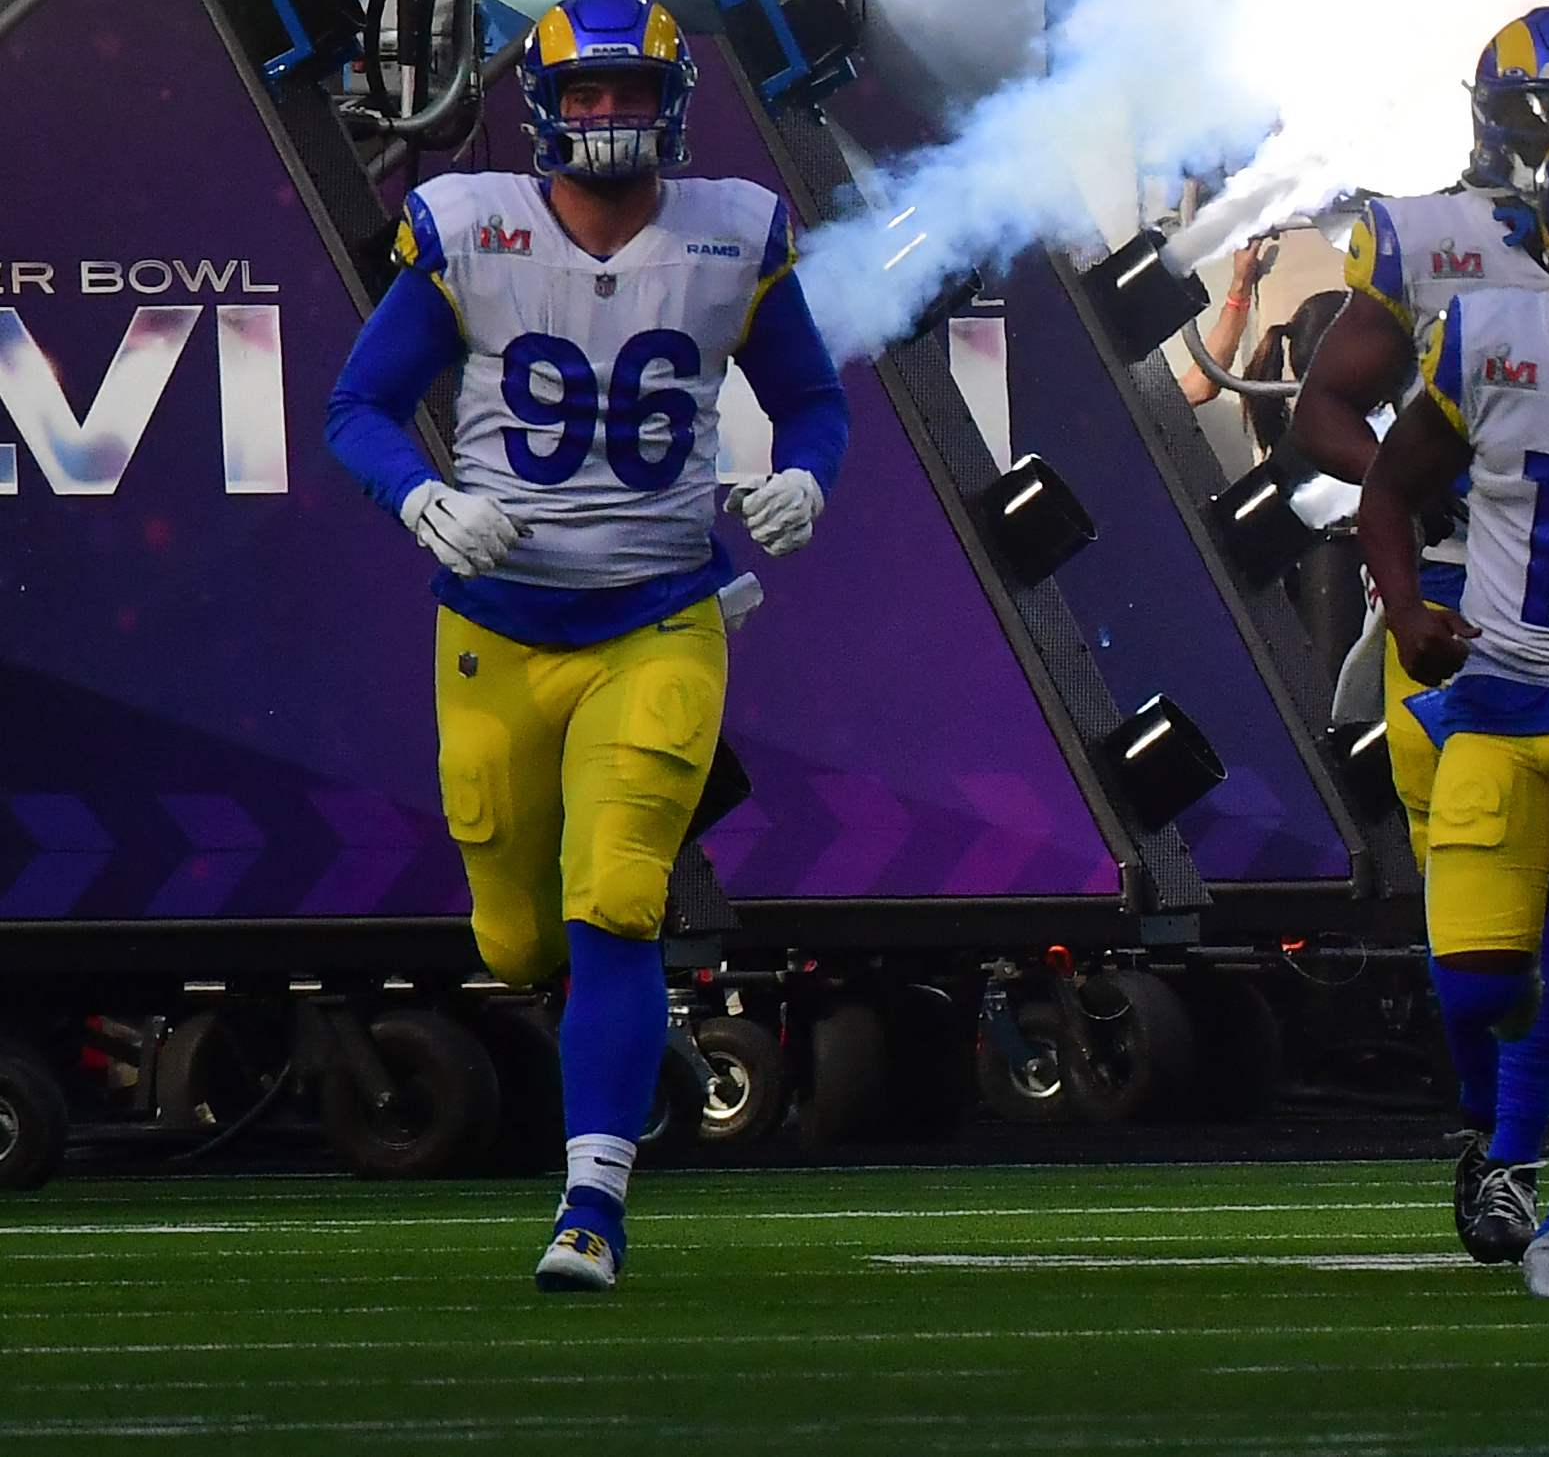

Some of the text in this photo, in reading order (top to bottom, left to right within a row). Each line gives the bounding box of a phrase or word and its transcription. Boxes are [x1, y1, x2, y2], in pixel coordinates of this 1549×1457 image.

[80, 259, 280, 294] BOWL
[687, 244, 740, 257] RAMS
[0, 304, 289, 495] VI
[501, 328, 701, 492] 96
